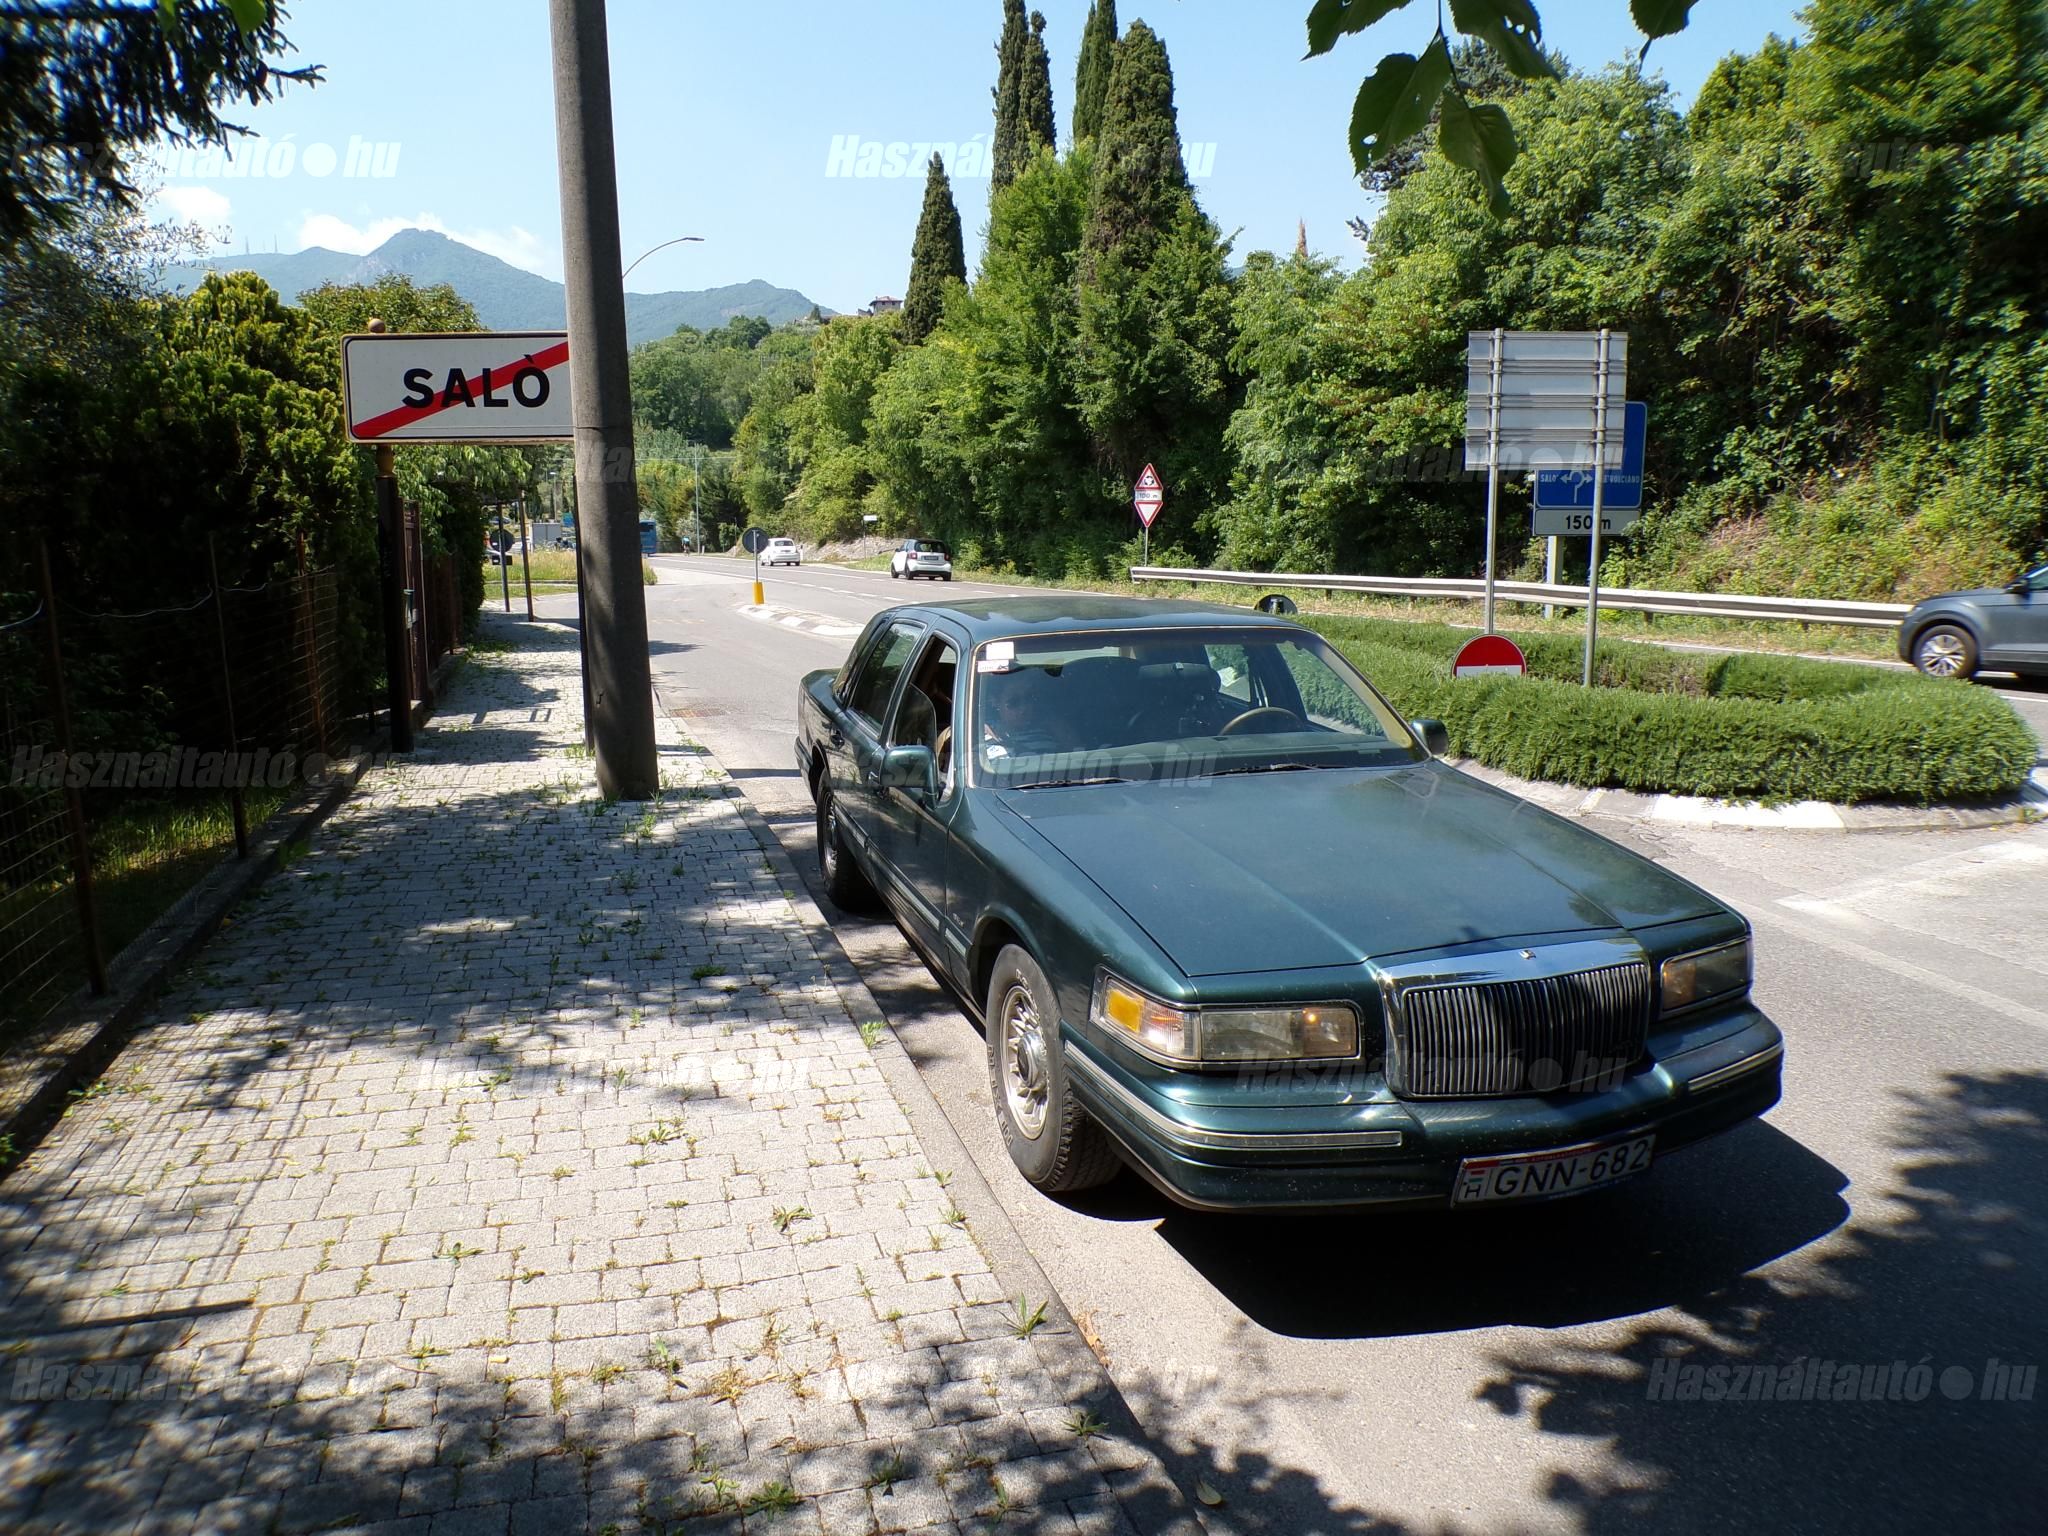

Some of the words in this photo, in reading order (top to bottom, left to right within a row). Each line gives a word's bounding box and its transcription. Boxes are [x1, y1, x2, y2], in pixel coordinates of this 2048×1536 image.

[402, 354, 550, 409] SALÒ
[1565, 515, 1593, 530] 150
[1600, 518, 1611, 530] m
[1464, 1184, 1481, 1199] H
[1494, 1139, 1649, 1196] GNN-682
